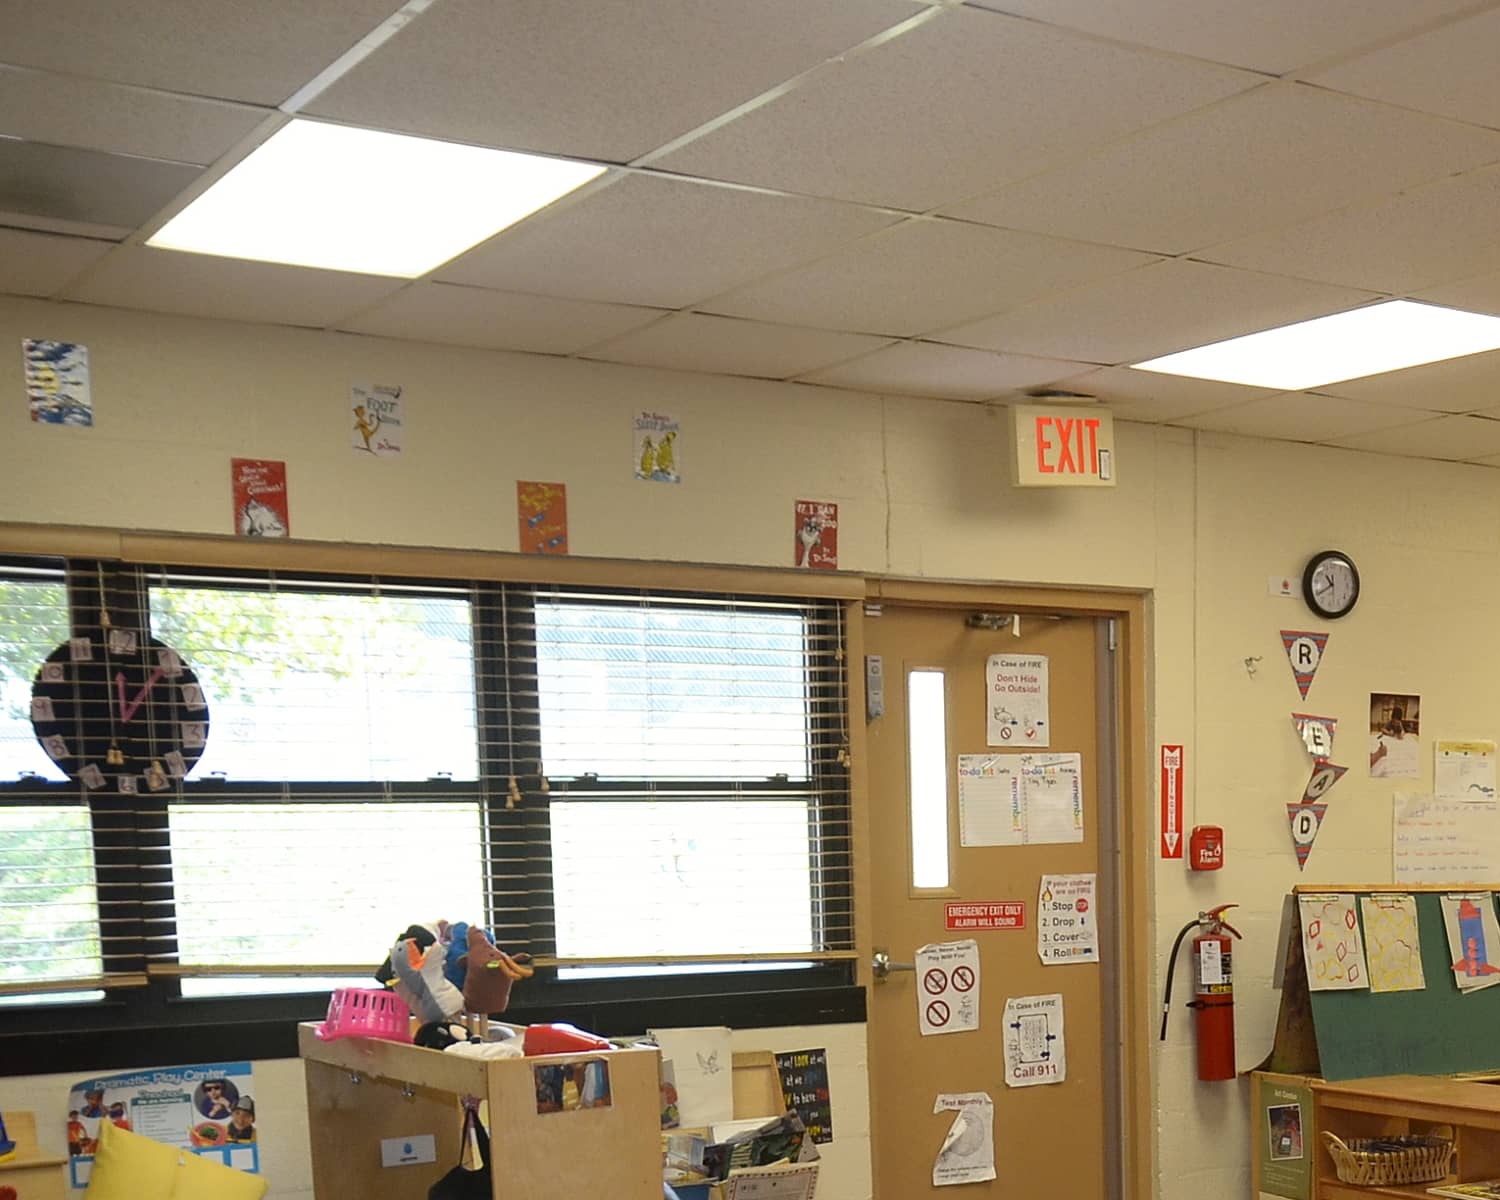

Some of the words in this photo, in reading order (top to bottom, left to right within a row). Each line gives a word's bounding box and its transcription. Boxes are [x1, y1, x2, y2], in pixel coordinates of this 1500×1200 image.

[1036, 416, 1099, 473] EXIT
[997, 674, 1018, 682] Don't
[1020, 675, 1038, 683] Hide
[994, 684, 1006, 692] Go
[1008, 684, 1041, 693] Outside!
[1199, 849, 1213, 858] Fire
[949, 906, 988, 917] EMERGENCY
[989, 906, 1003, 915] EXIT
[1005, 905, 1021, 915] ONLY
[1052, 902, 1073, 911] Stop
[955, 918, 976, 926] ALARM
[1053, 917, 1075, 927] Drop
[1053, 932, 1079, 941] Cover
[1053, 948, 1072, 957] Roll
[1013, 1066, 1035, 1078] Call
[1037, 1064, 1057, 1076] 911
[94, 1076, 151, 1091] Dramatic
[152, 1070, 183, 1085] Play
[183, 1068, 226, 1081] Center
